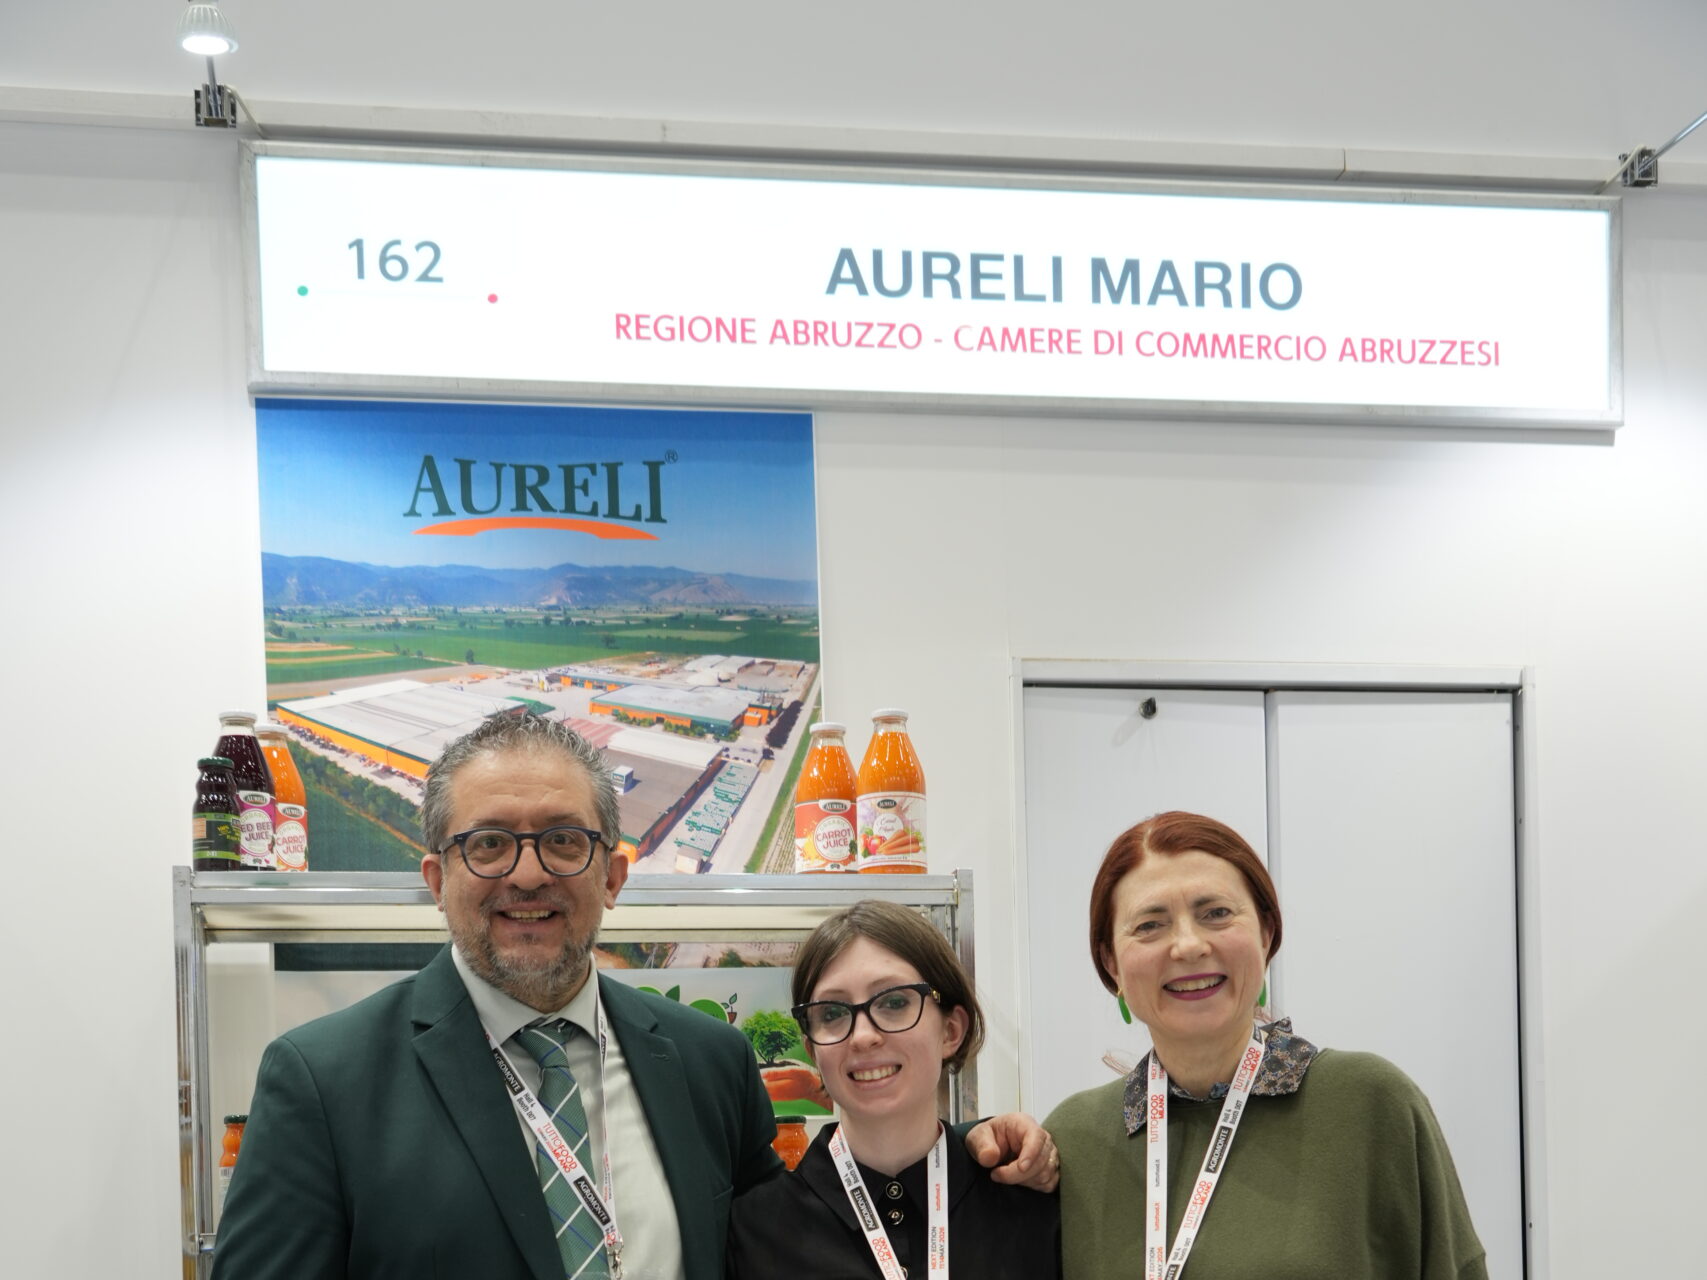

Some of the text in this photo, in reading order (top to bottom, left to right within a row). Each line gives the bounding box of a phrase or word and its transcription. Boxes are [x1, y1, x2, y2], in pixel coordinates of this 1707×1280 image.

[347, 238, 444, 283] 162
[825, 247, 1303, 311] AURELI MARIO
[615, 313, 757, 346] REGIONE
[768, 319, 923, 351] ABRUZZO
[953, 325, 1082, 355] CAMERE
[1094, 330, 1124, 357] DI
[1135, 331, 1327, 362] COMMERCIO
[1338, 336, 1500, 367] ABRUZZESI
[404, 454, 668, 524] AURELI
[245, 831, 270, 841] JUICE
[823, 838, 849, 849] JUICE
[1150, 1094, 1158, 1143] TUTTOFOOD
[1208, 1128, 1229, 1171] AGROMONTE
[577, 1179, 610, 1223] AGROMONTE
[853, 1189, 876, 1229] AGROMONTE
